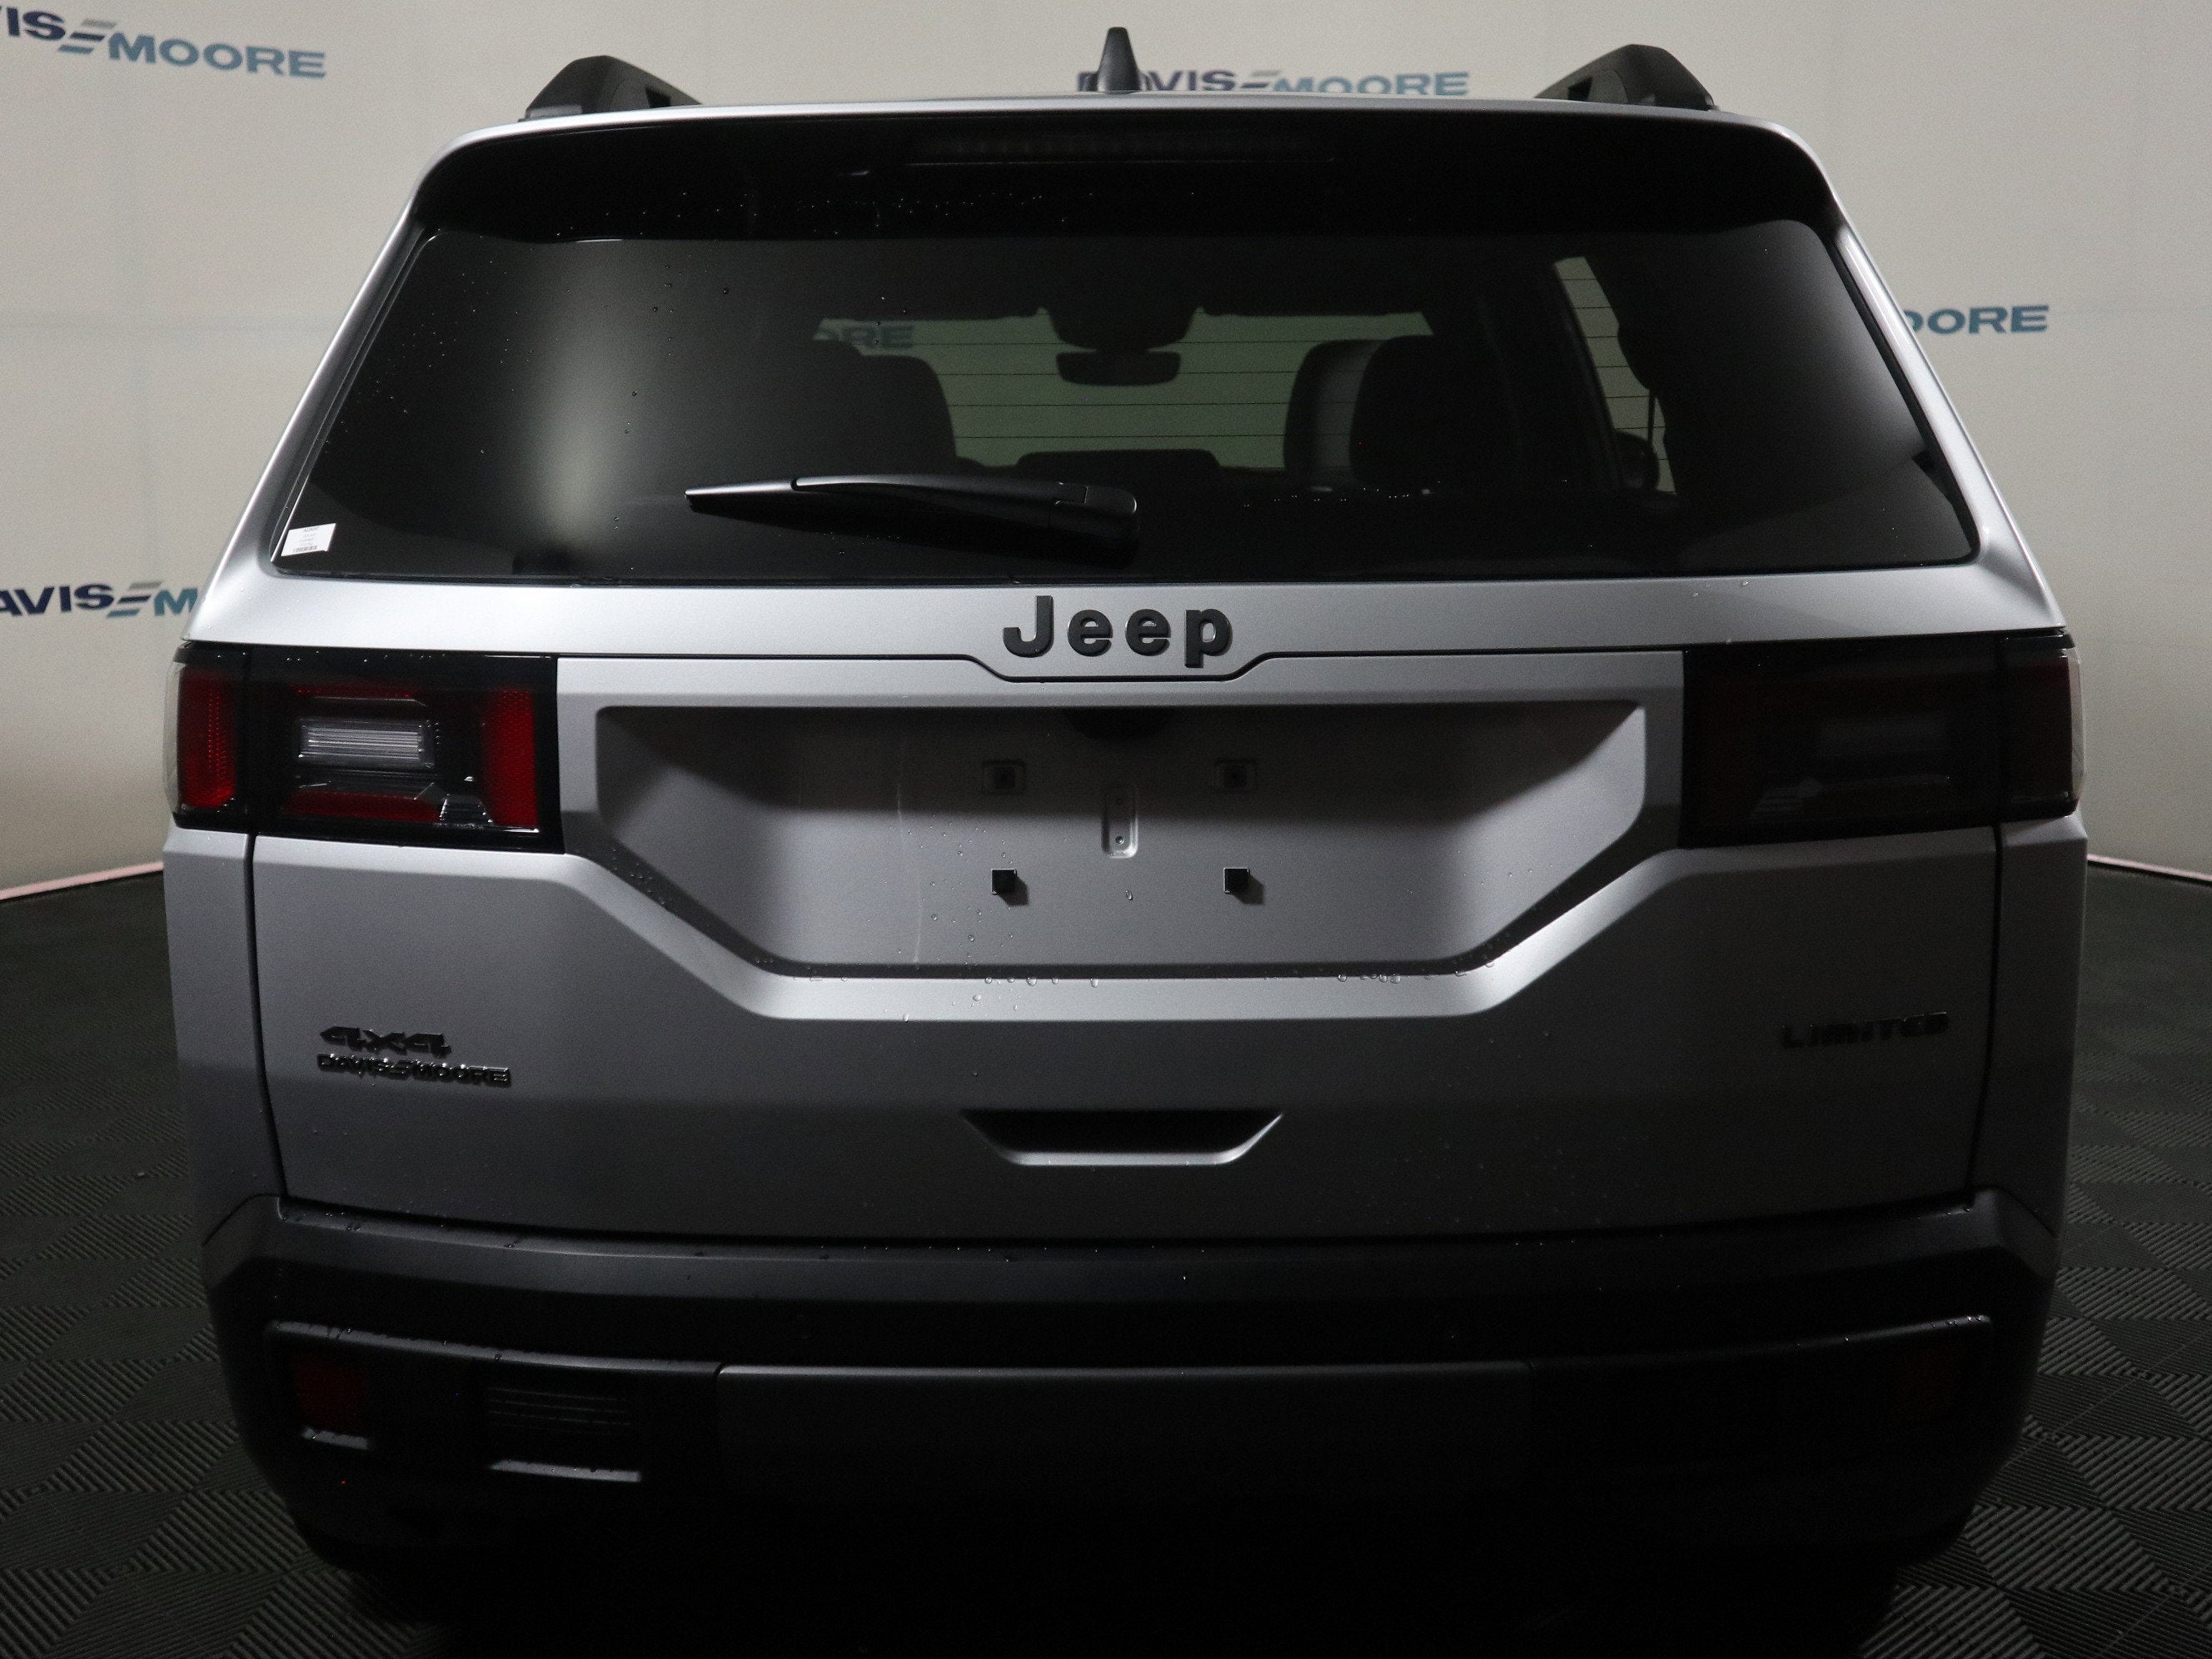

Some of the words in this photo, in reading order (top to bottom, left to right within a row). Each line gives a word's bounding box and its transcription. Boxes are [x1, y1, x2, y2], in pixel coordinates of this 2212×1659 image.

[107, 32, 326, 78] MOORE
[1003, 595, 1233, 668] Jeep
[1783, 1011, 1949, 1049] LIMITED
